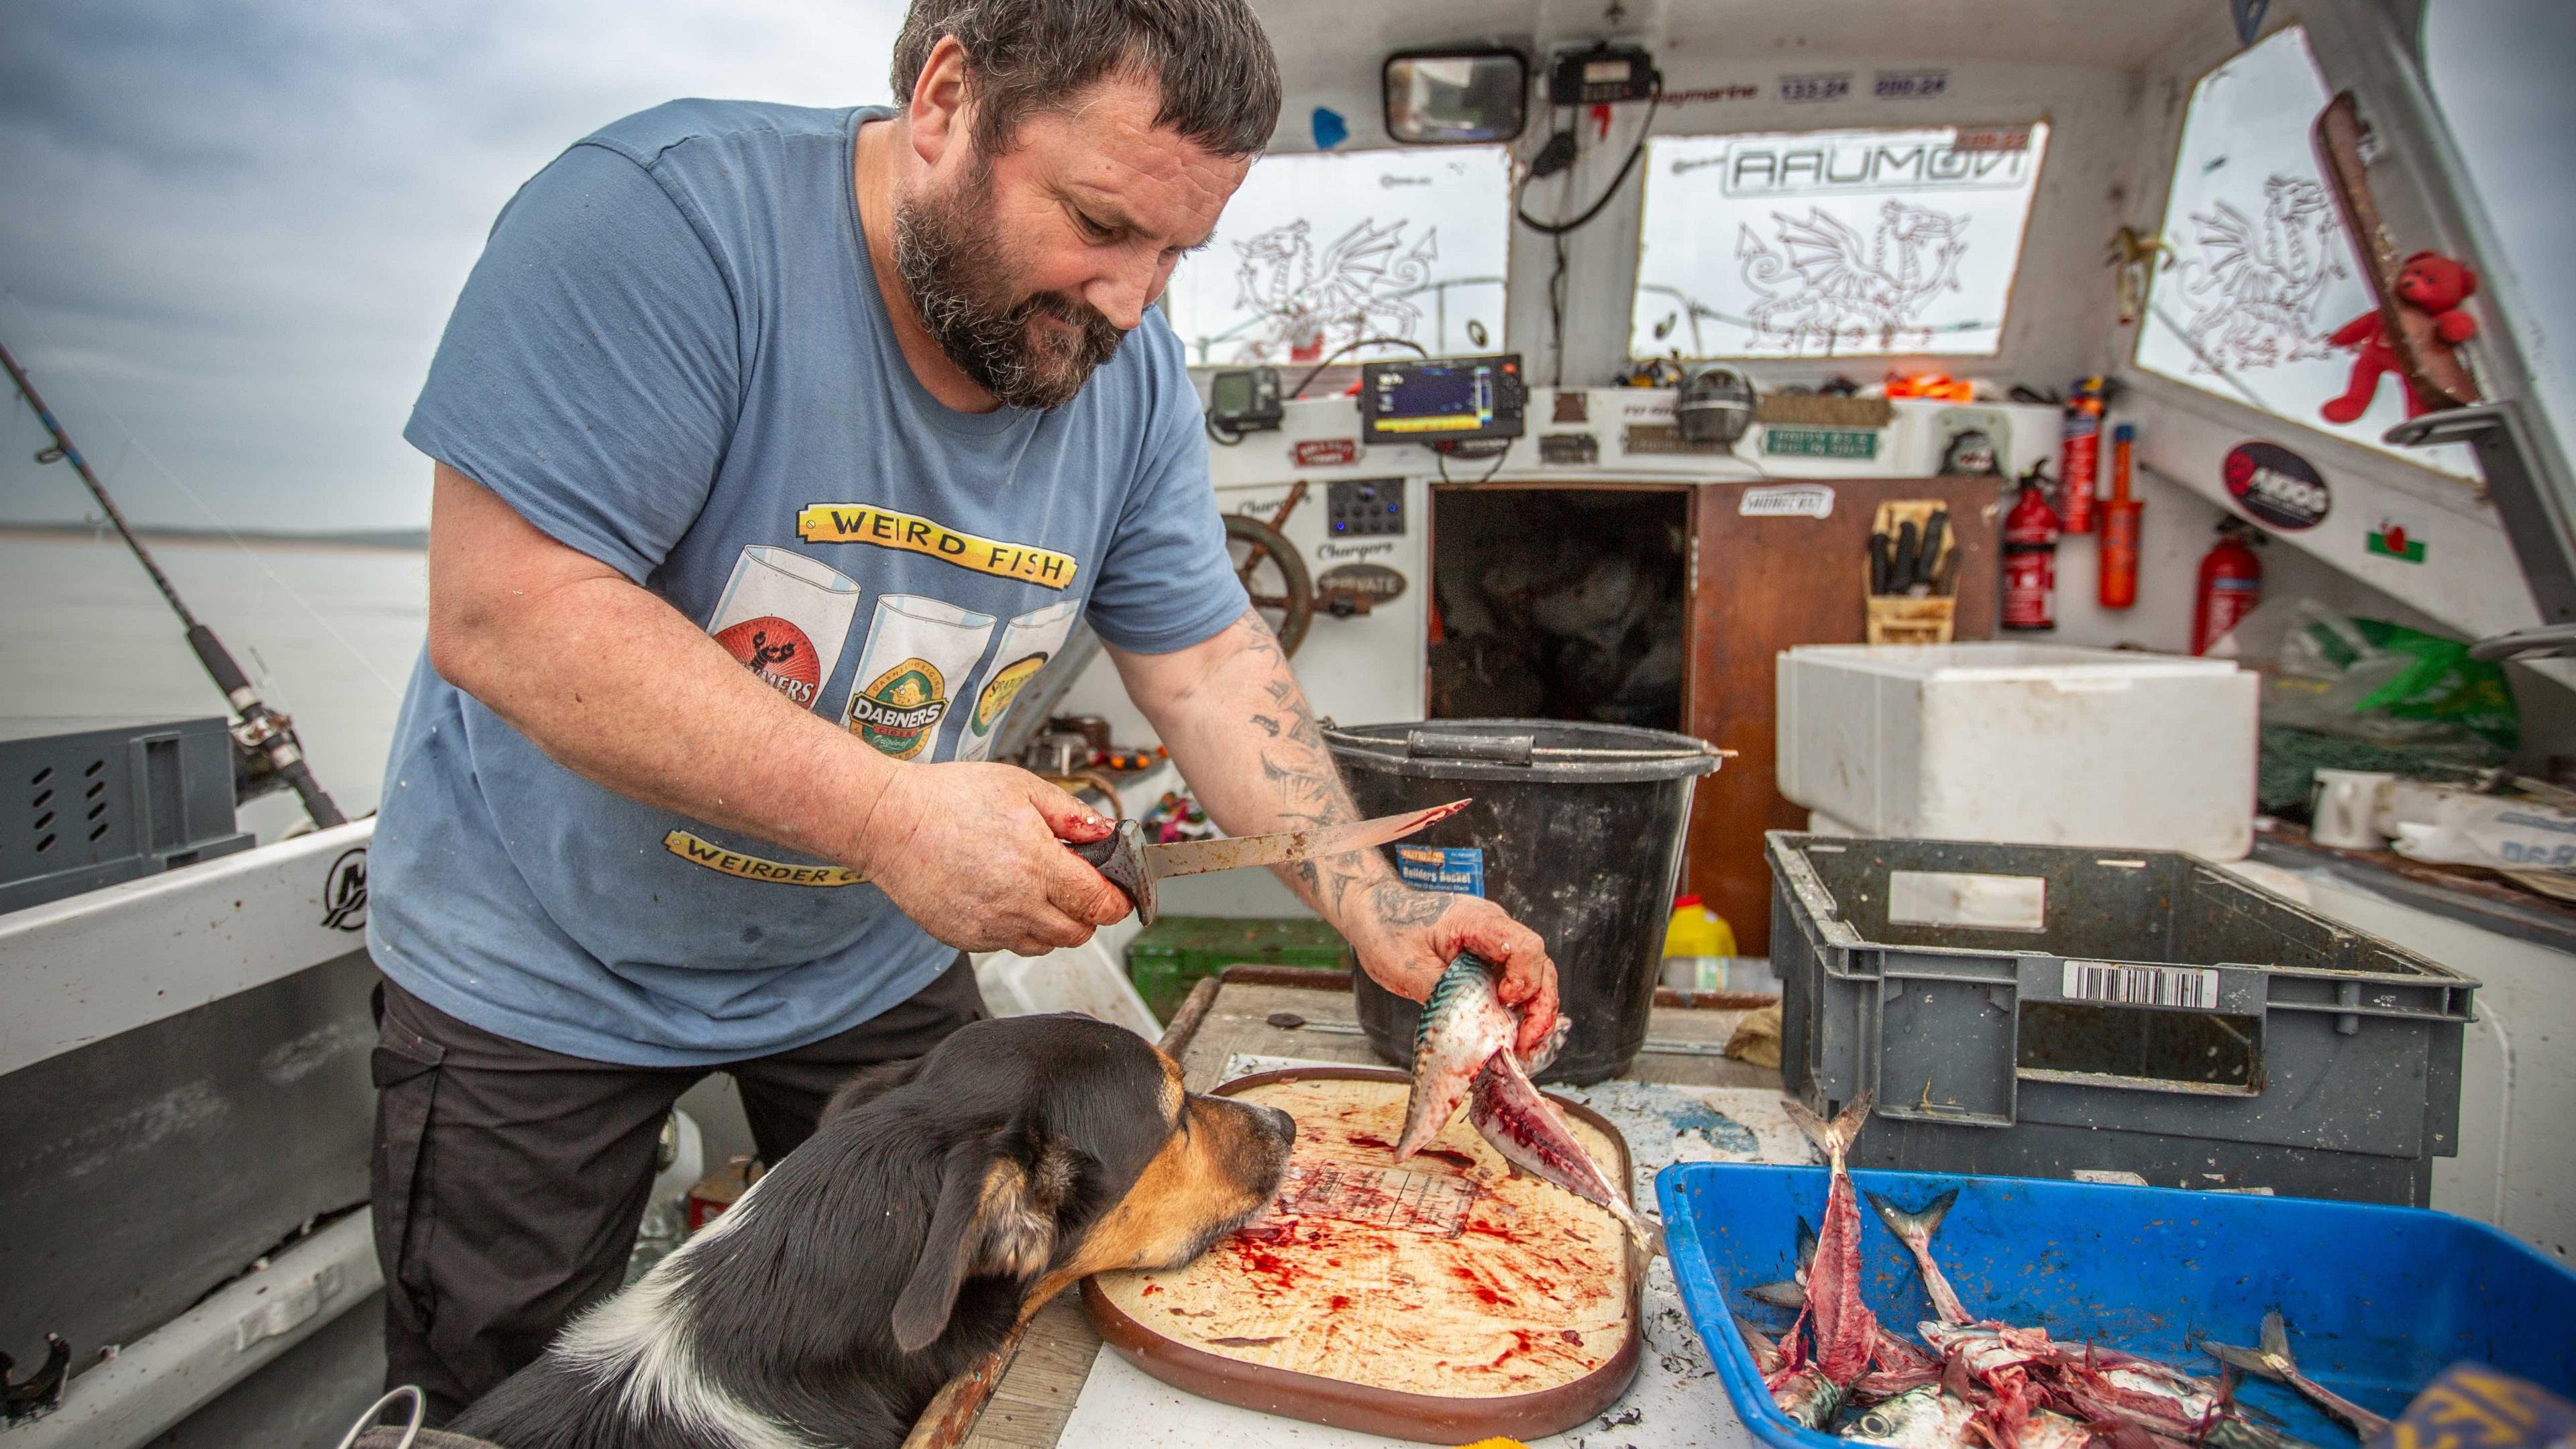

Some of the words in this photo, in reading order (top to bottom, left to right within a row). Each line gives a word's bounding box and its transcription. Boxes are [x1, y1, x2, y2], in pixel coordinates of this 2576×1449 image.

[831, 511, 966, 555] WEIRD
[987, 548, 1065, 580] FISH
[1316, 541, 1393, 564] Chargers
[853, 698, 943, 727] DABNERS
[879, 728, 912, 737] CIDER
[688, 839, 830, 882] WEIRDER
[1403, 867, 1437, 882] Builders
[1440, 871, 1471, 883] Bucket
